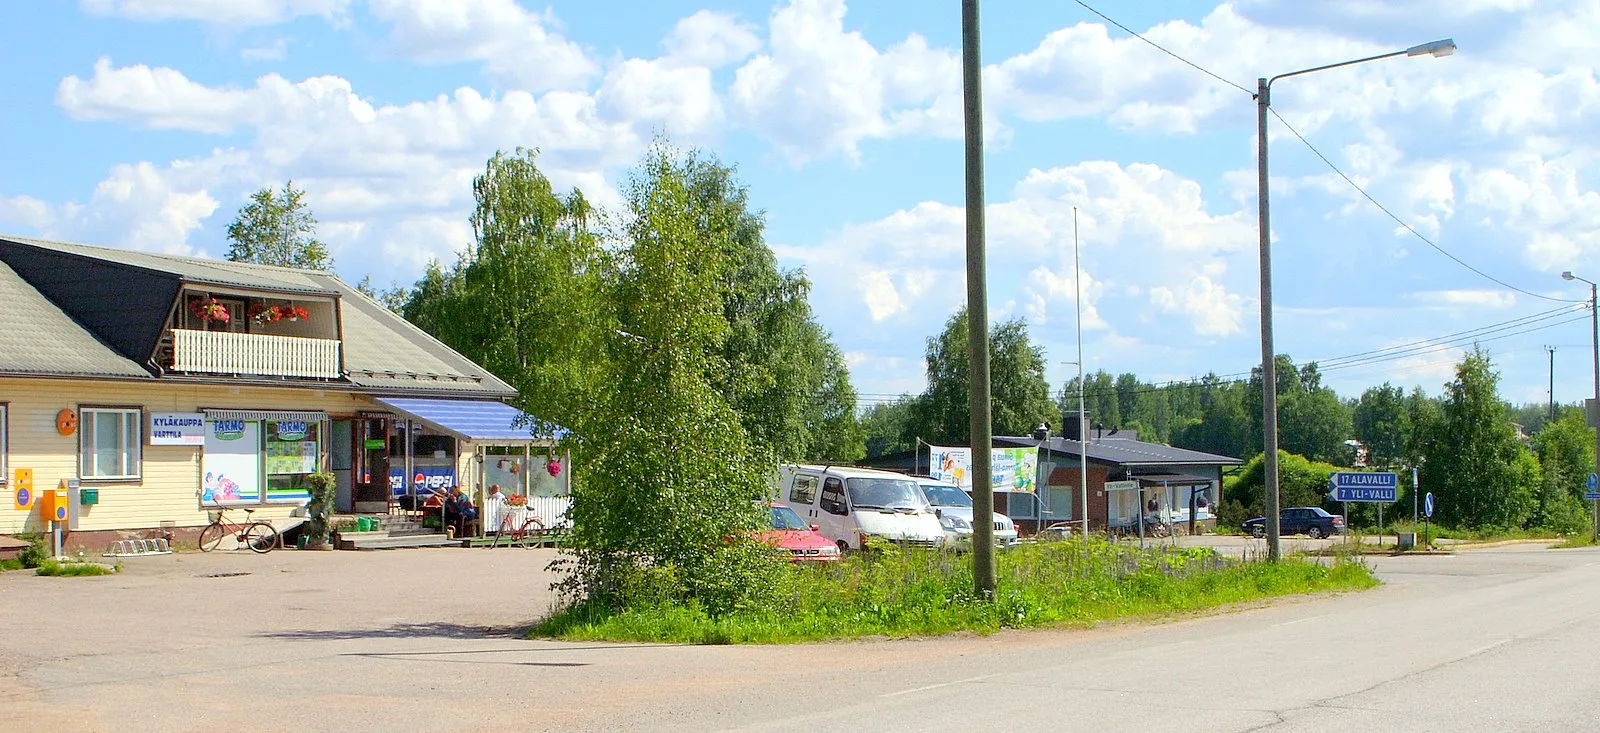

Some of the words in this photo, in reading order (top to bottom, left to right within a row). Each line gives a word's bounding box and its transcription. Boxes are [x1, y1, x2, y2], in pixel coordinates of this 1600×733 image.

[153, 416, 203, 427] KYLÄKAUPPA
[213, 419, 245, 431] TARMO
[277, 420, 307, 432] TARMO
[153, 430, 182, 439] VARTTILA
[425, 475, 453, 488] PEPSI
[1341, 475, 1349, 484] 17
[1351, 475, 1391, 484] ALAVALLI
[1341, 490, 1346, 498] 7
[1351, 490, 1393, 498] YLI-VALLI
